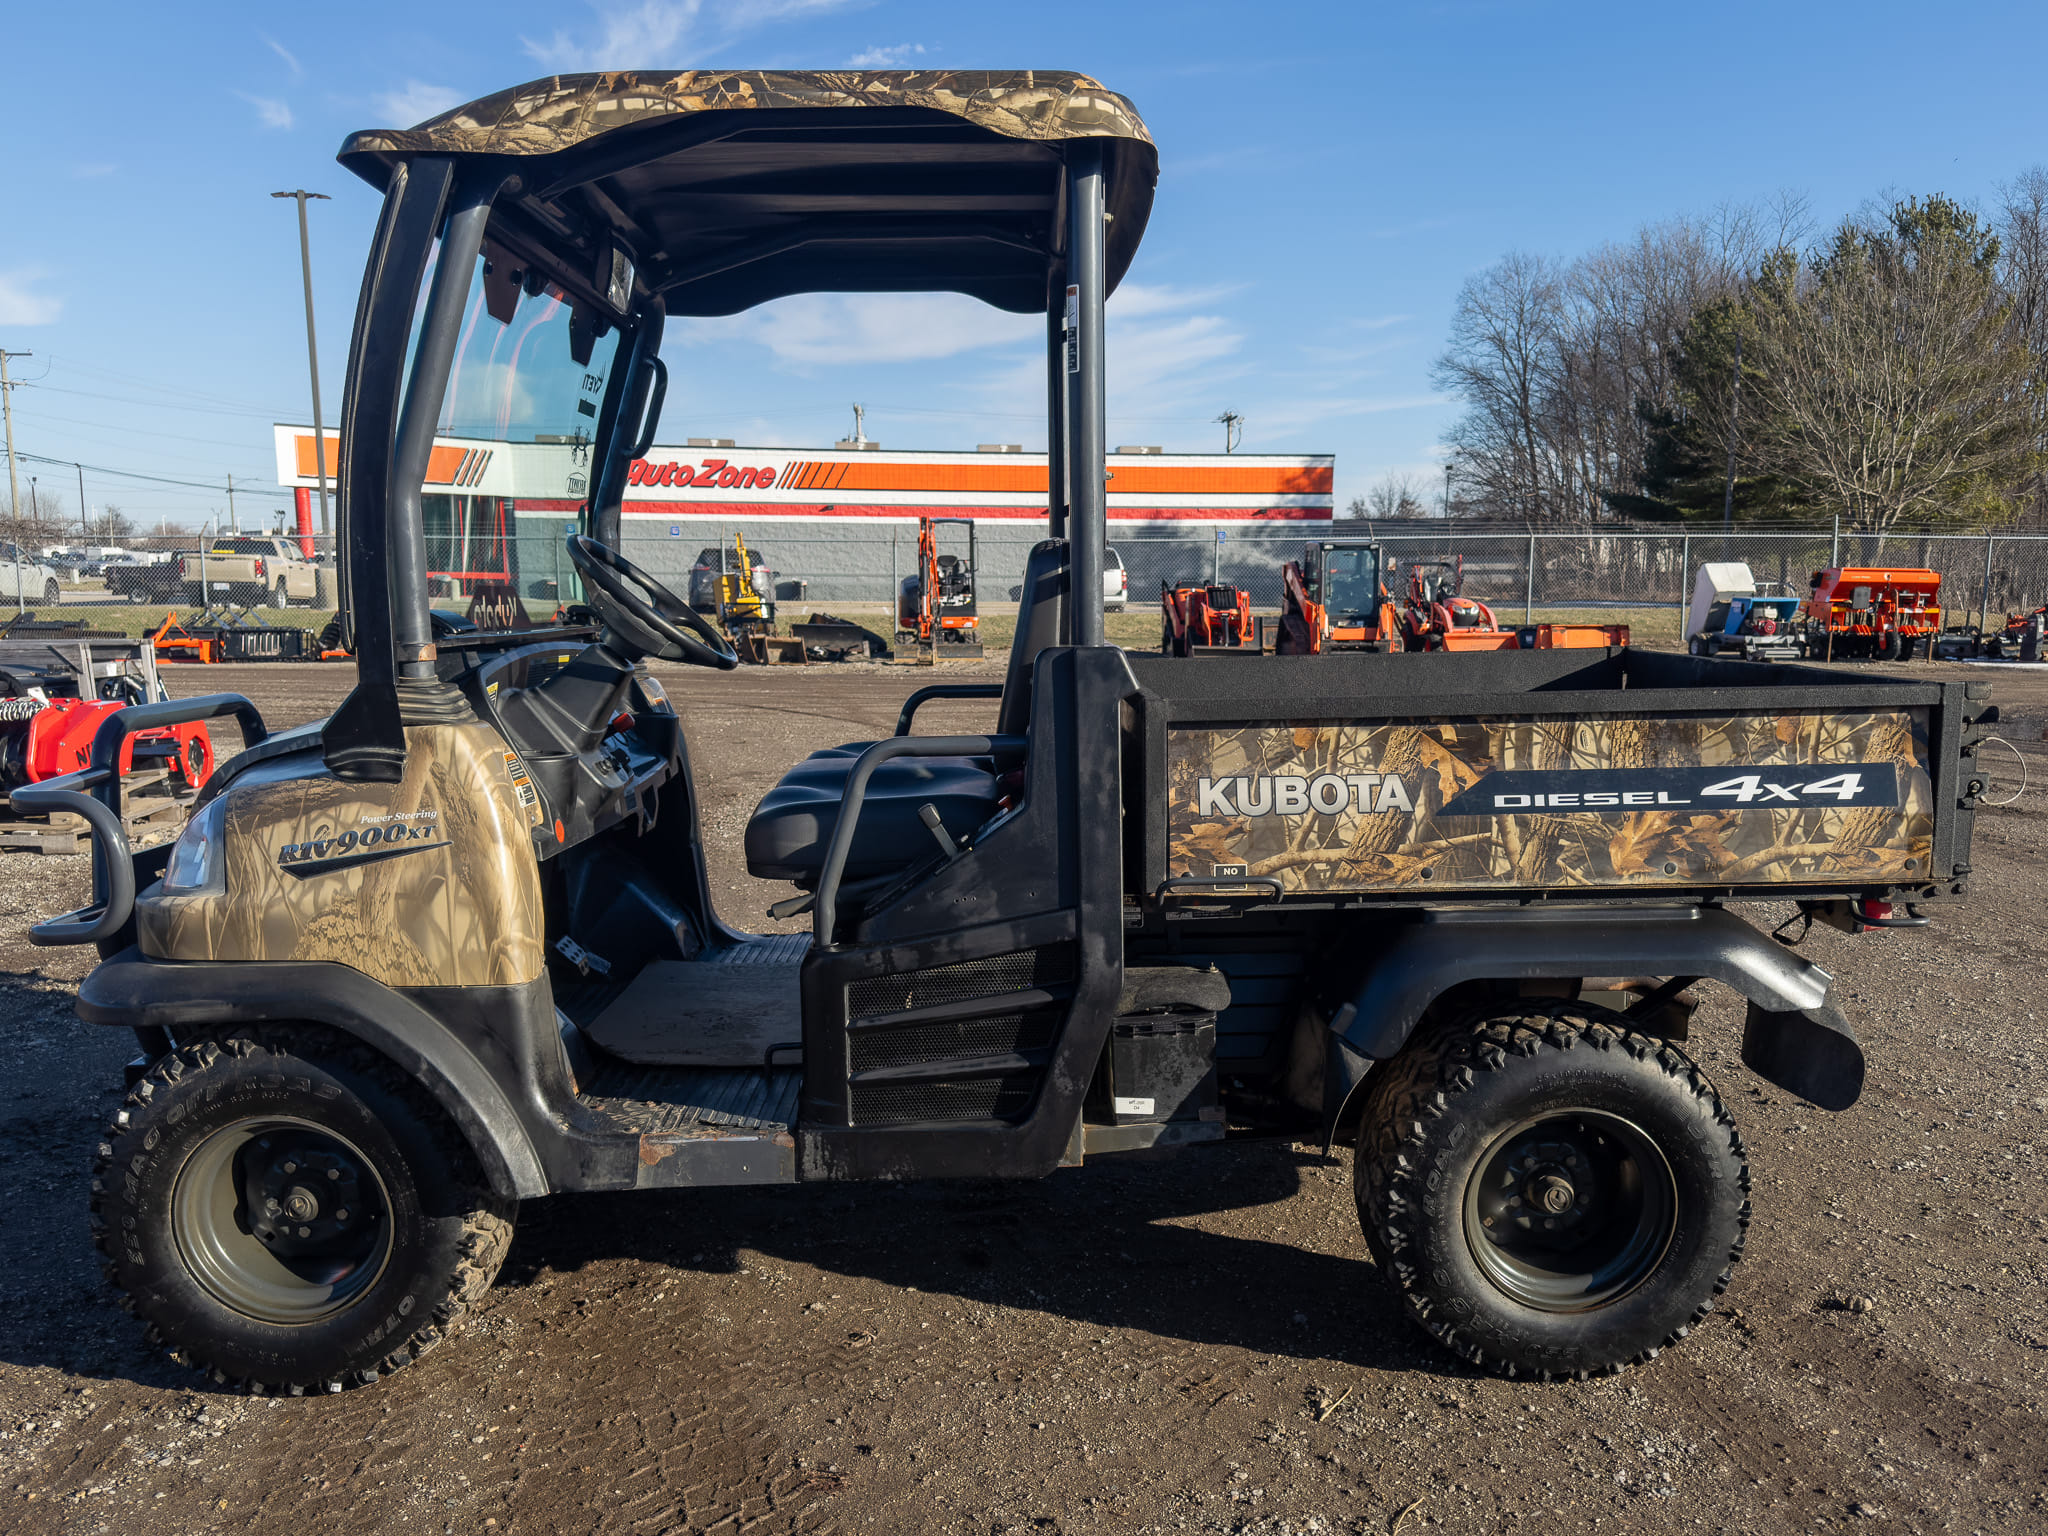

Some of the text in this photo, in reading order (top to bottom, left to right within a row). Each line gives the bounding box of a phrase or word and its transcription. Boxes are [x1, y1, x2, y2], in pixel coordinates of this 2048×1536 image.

[627, 458, 776, 488] AutoZone
[1198, 773, 1415, 817] KUBOTA
[1494, 773, 1865, 808] DIESEL 4x4
[360, 809, 438, 825] Power Steering
[1223, 867, 1239, 876] NO
[1422, 1121, 1466, 1217] ROAD
[366, 1295, 416, 1347] OTR
